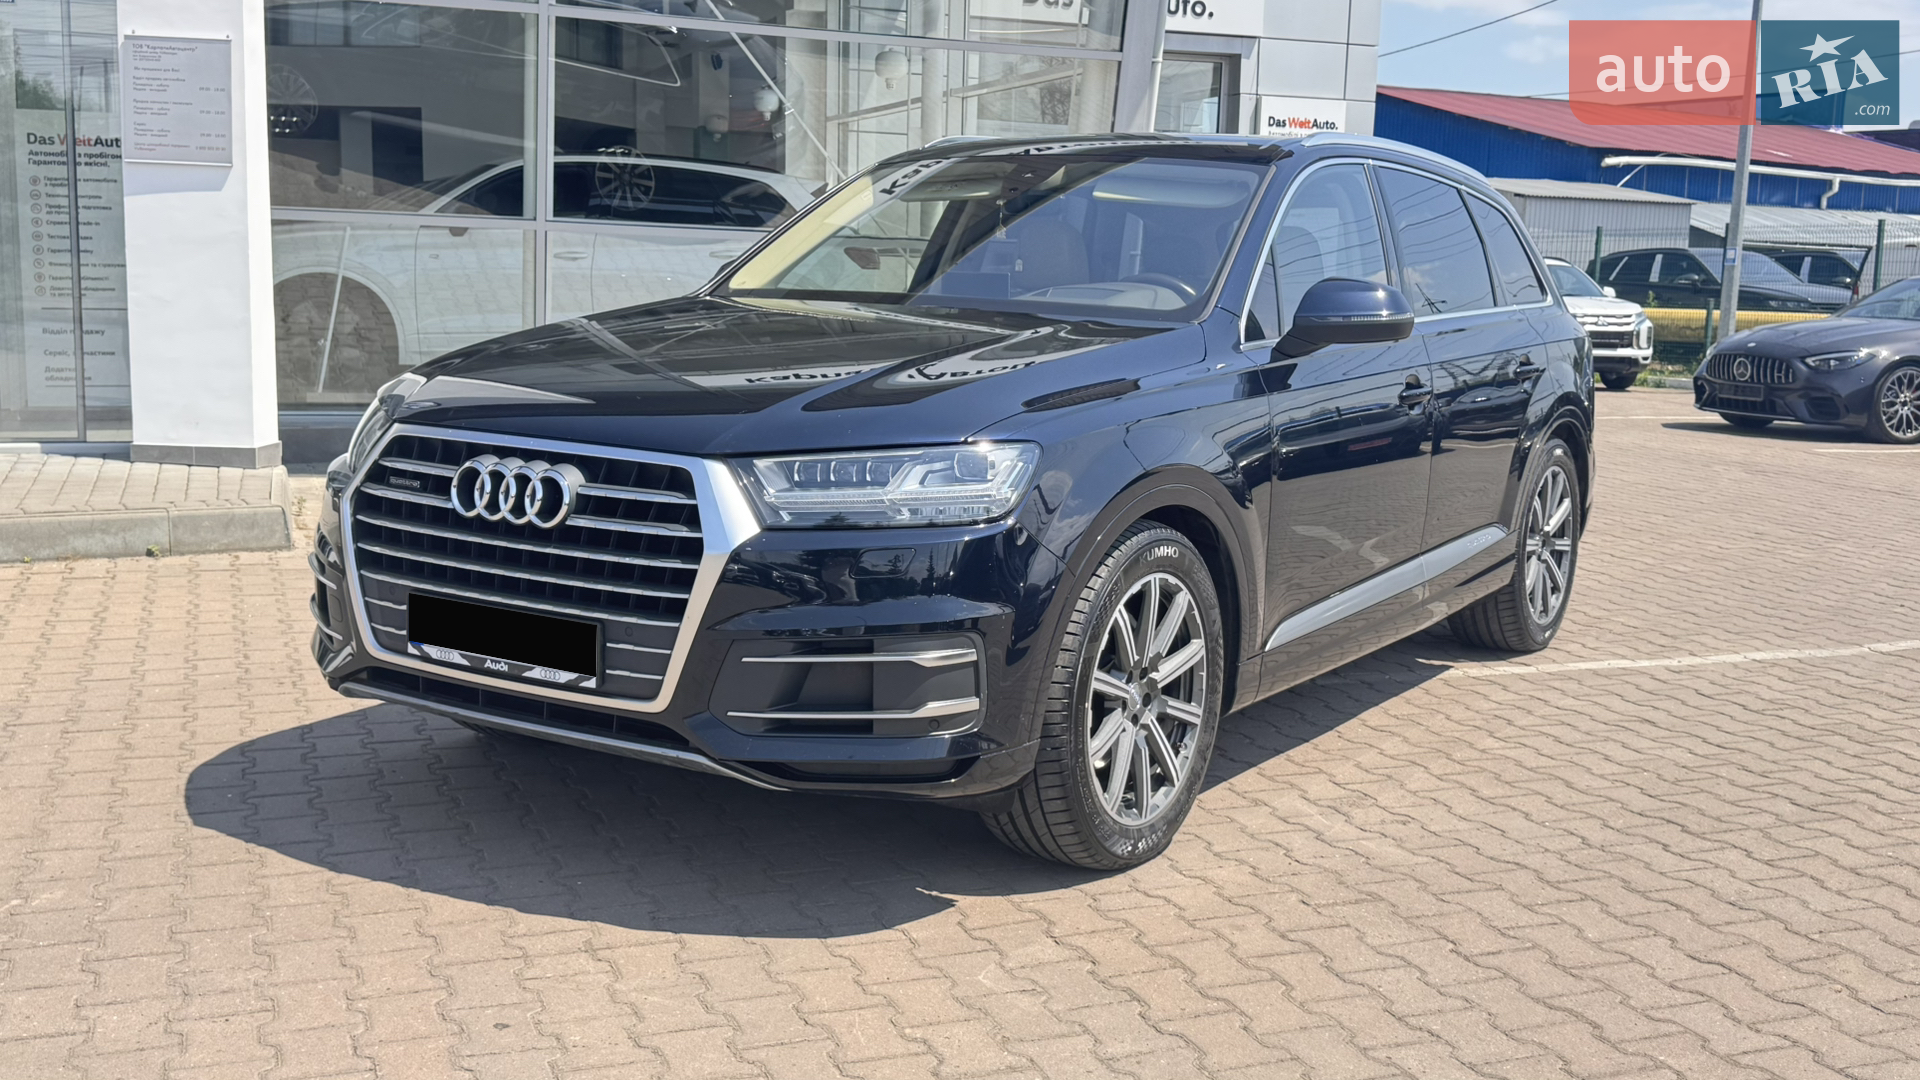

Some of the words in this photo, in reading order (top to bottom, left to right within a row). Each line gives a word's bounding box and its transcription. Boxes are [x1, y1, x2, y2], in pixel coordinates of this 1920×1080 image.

[1268, 116, 1286, 127] Das
[27, 132, 55, 146] Das
[57, 133, 122, 148] WeltAut
[28, 158, 82, 166] Гарантово
[484, 659, 509, 672] Audi
